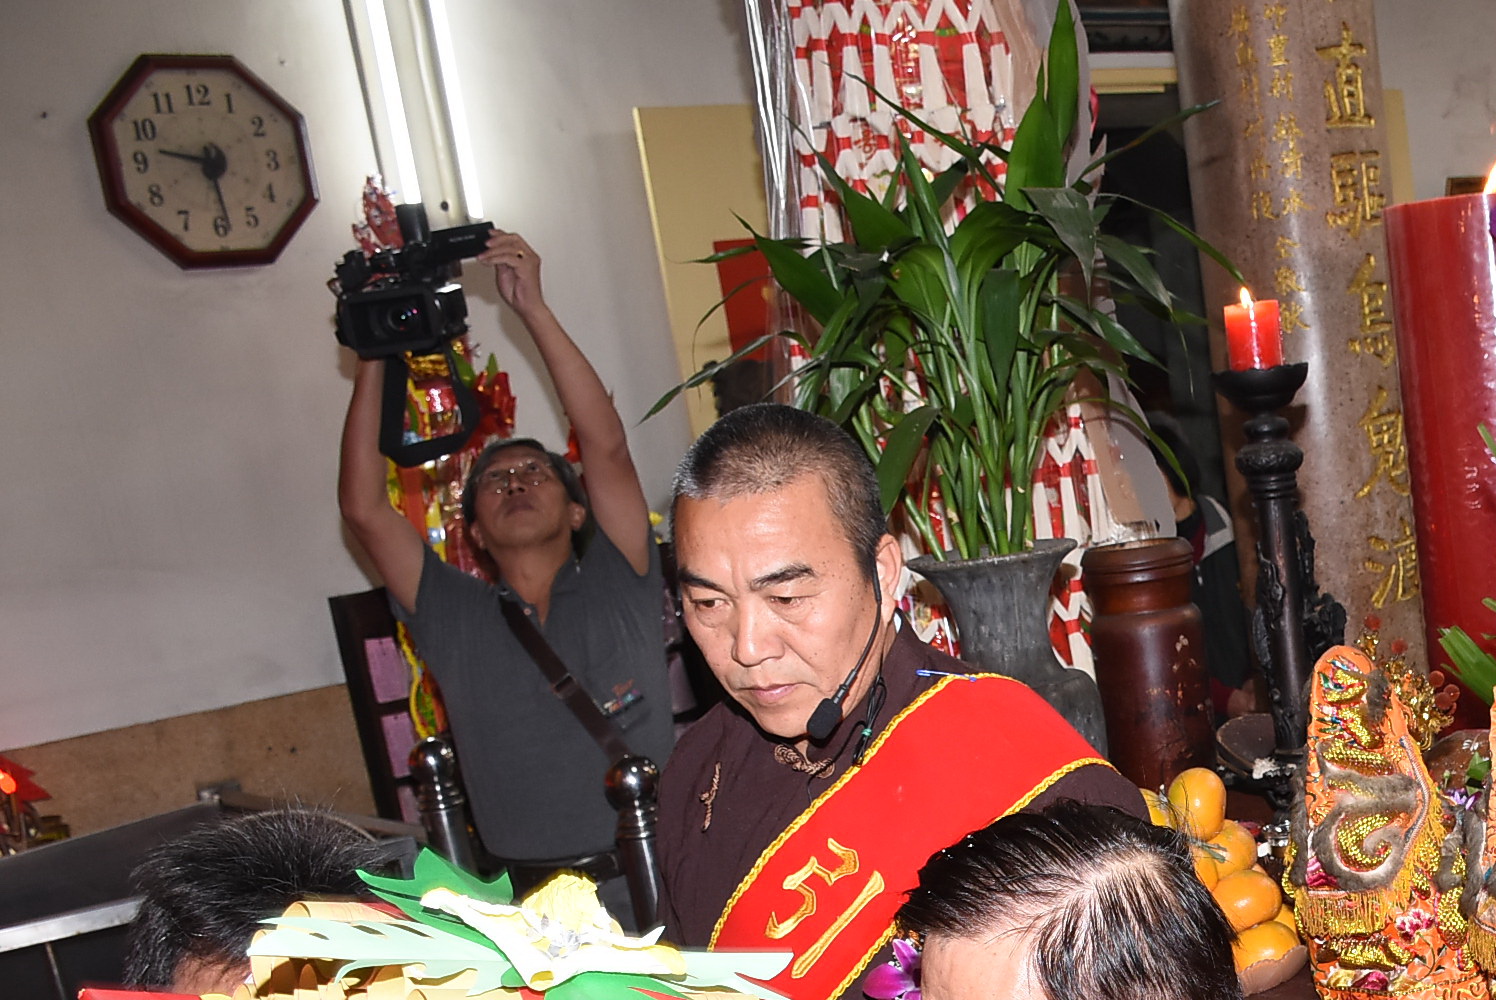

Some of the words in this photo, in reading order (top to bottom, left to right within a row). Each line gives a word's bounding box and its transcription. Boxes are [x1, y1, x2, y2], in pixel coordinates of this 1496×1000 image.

[152, 92, 176, 114] 11
[184, 83, 212, 107] 12
[224, 93, 235, 114] 1
[132, 118, 157, 141] 10
[251, 116, 267, 137] 2
[133, 151, 149, 174] 9
[266, 150, 280, 172] 3
[148, 184, 165, 207] 8
[263, 183, 277, 203] 4
[177, 209, 190, 231] 7
[213, 215, 231, 238] 6
[244, 206, 259, 229] 5
[764, 837, 887, 980] 引
